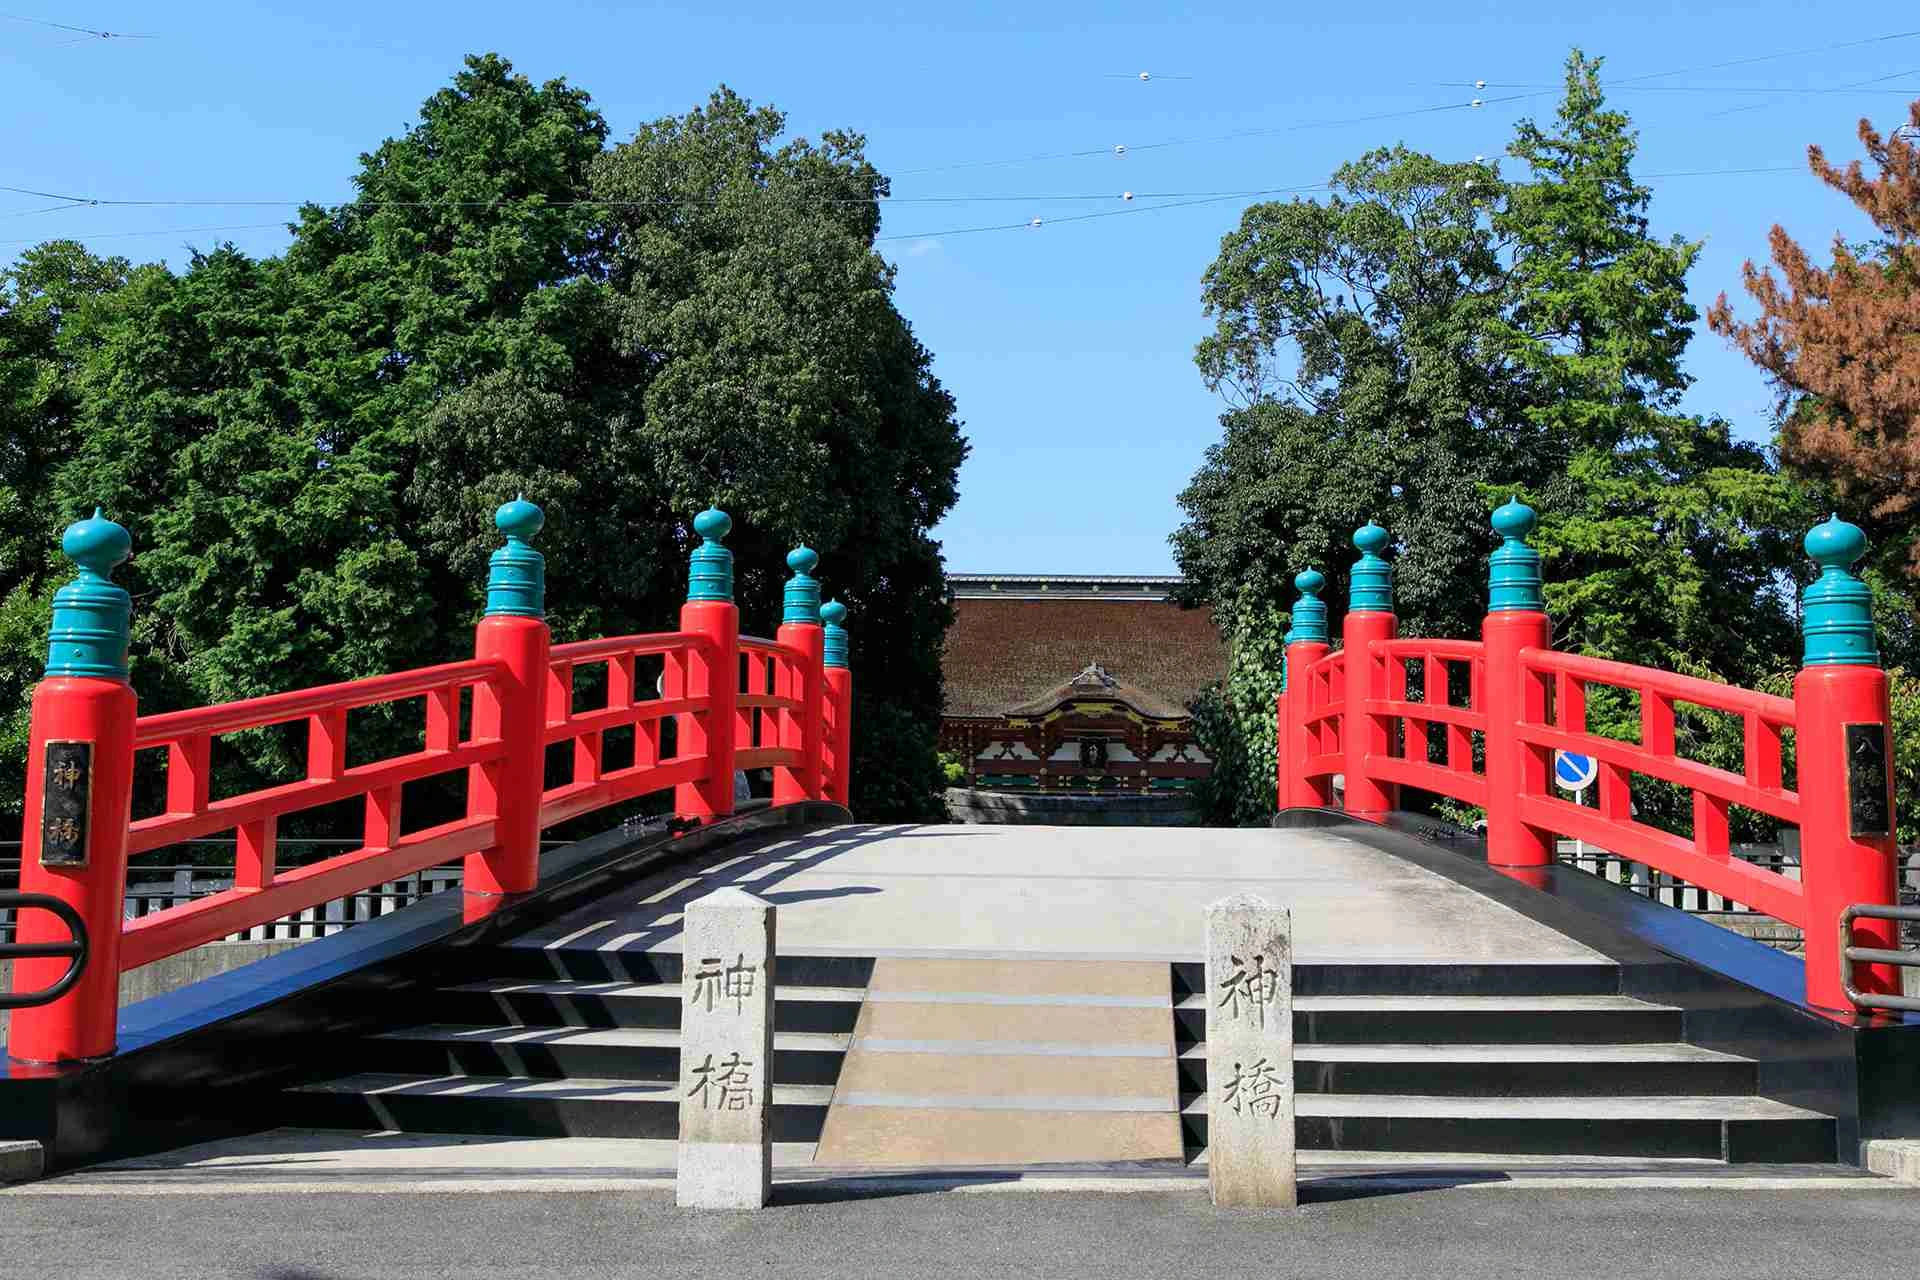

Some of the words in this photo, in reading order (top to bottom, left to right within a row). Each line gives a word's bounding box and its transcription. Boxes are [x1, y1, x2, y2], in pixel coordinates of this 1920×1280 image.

[49, 760, 80, 849] 神橋
[688, 953, 756, 1111] 神橋
[1219, 955, 1286, 1119] 神橋
